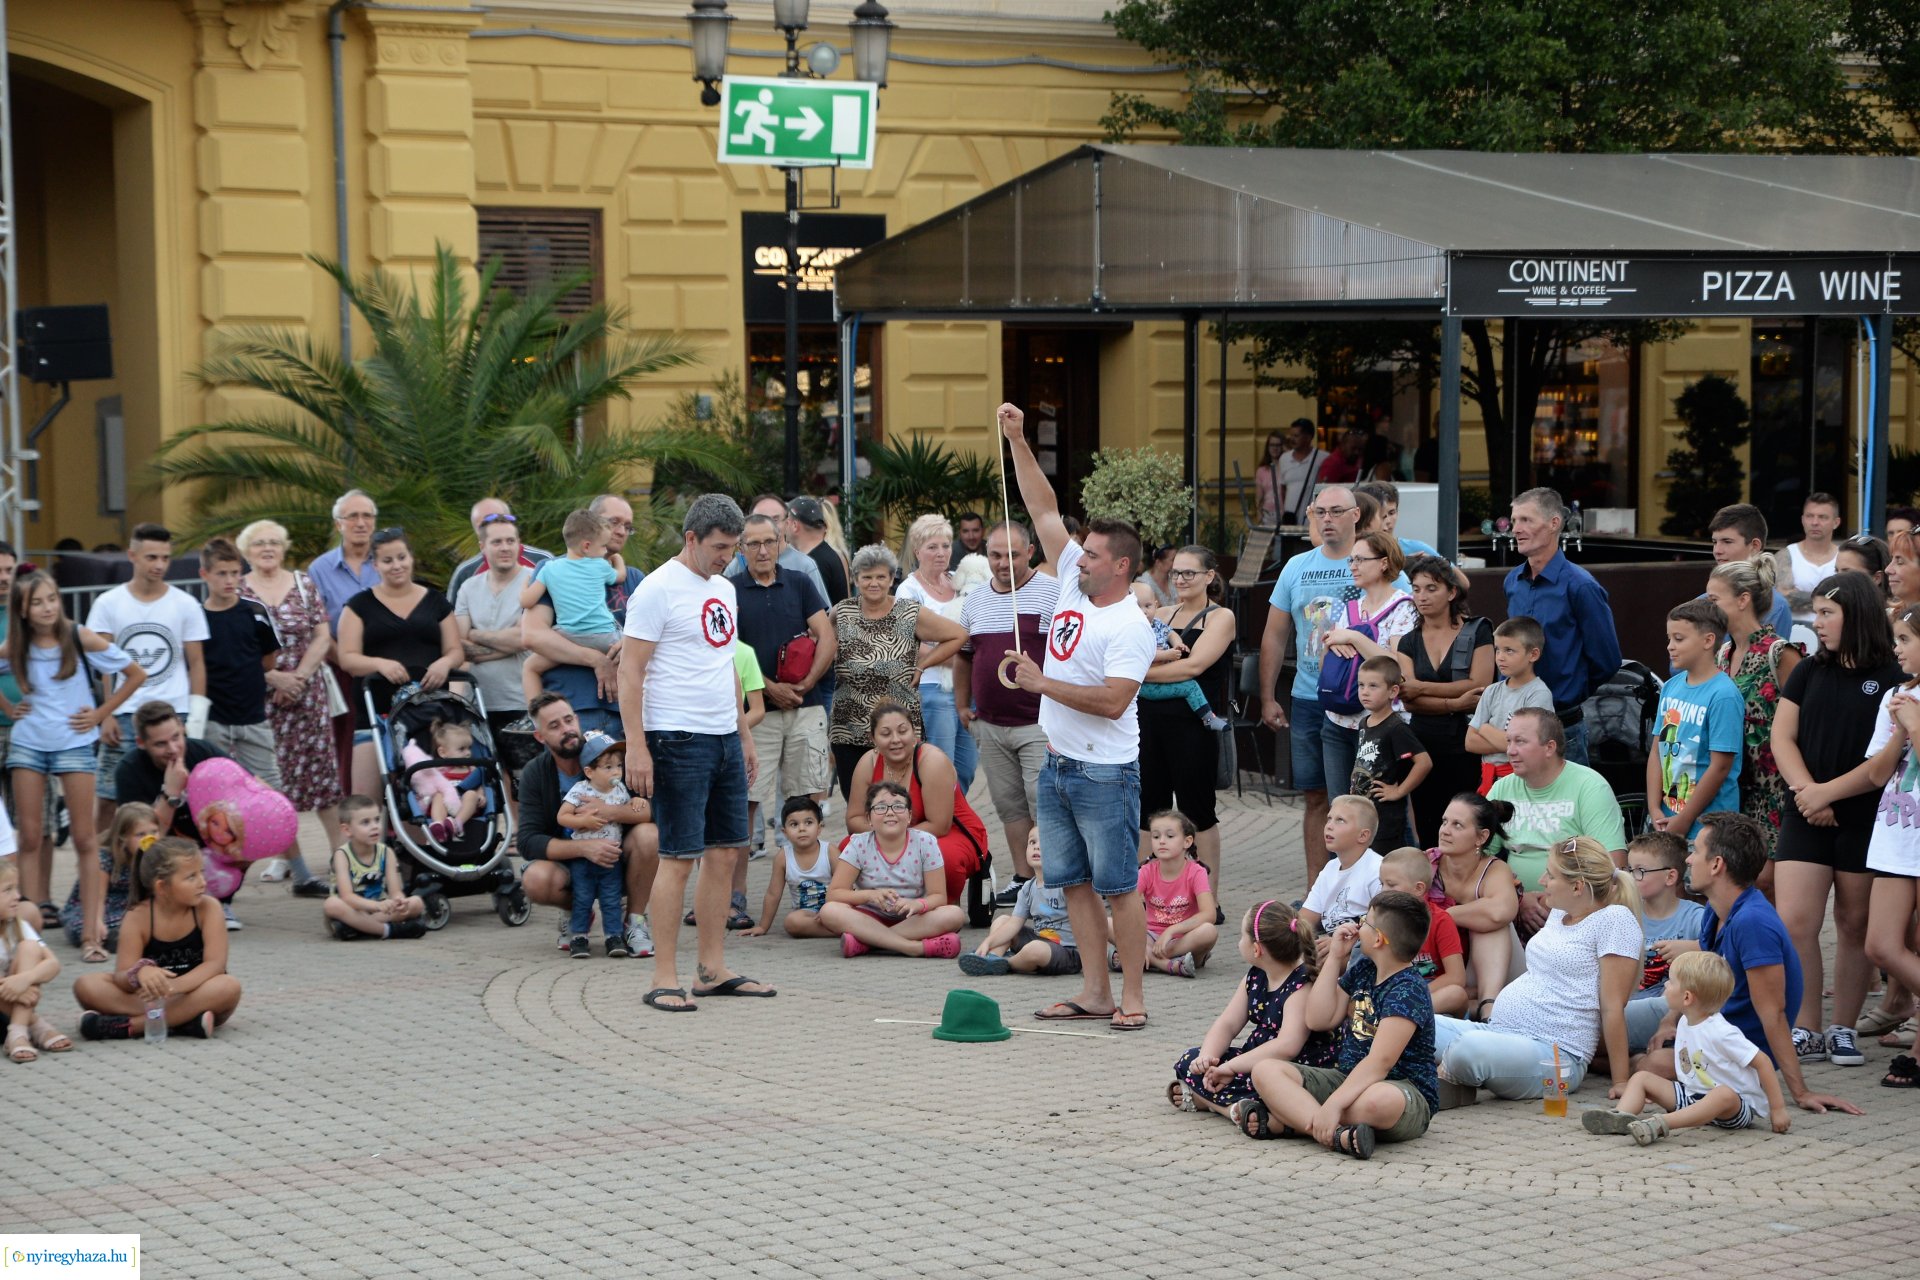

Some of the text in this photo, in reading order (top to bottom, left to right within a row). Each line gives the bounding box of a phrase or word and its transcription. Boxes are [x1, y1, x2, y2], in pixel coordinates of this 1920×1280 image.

[1509, 260, 1630, 282] CONTINENT
[1532, 285, 1606, 295] WINE & COFFEE
[1703, 271, 1901, 300] PIZZA WINE
